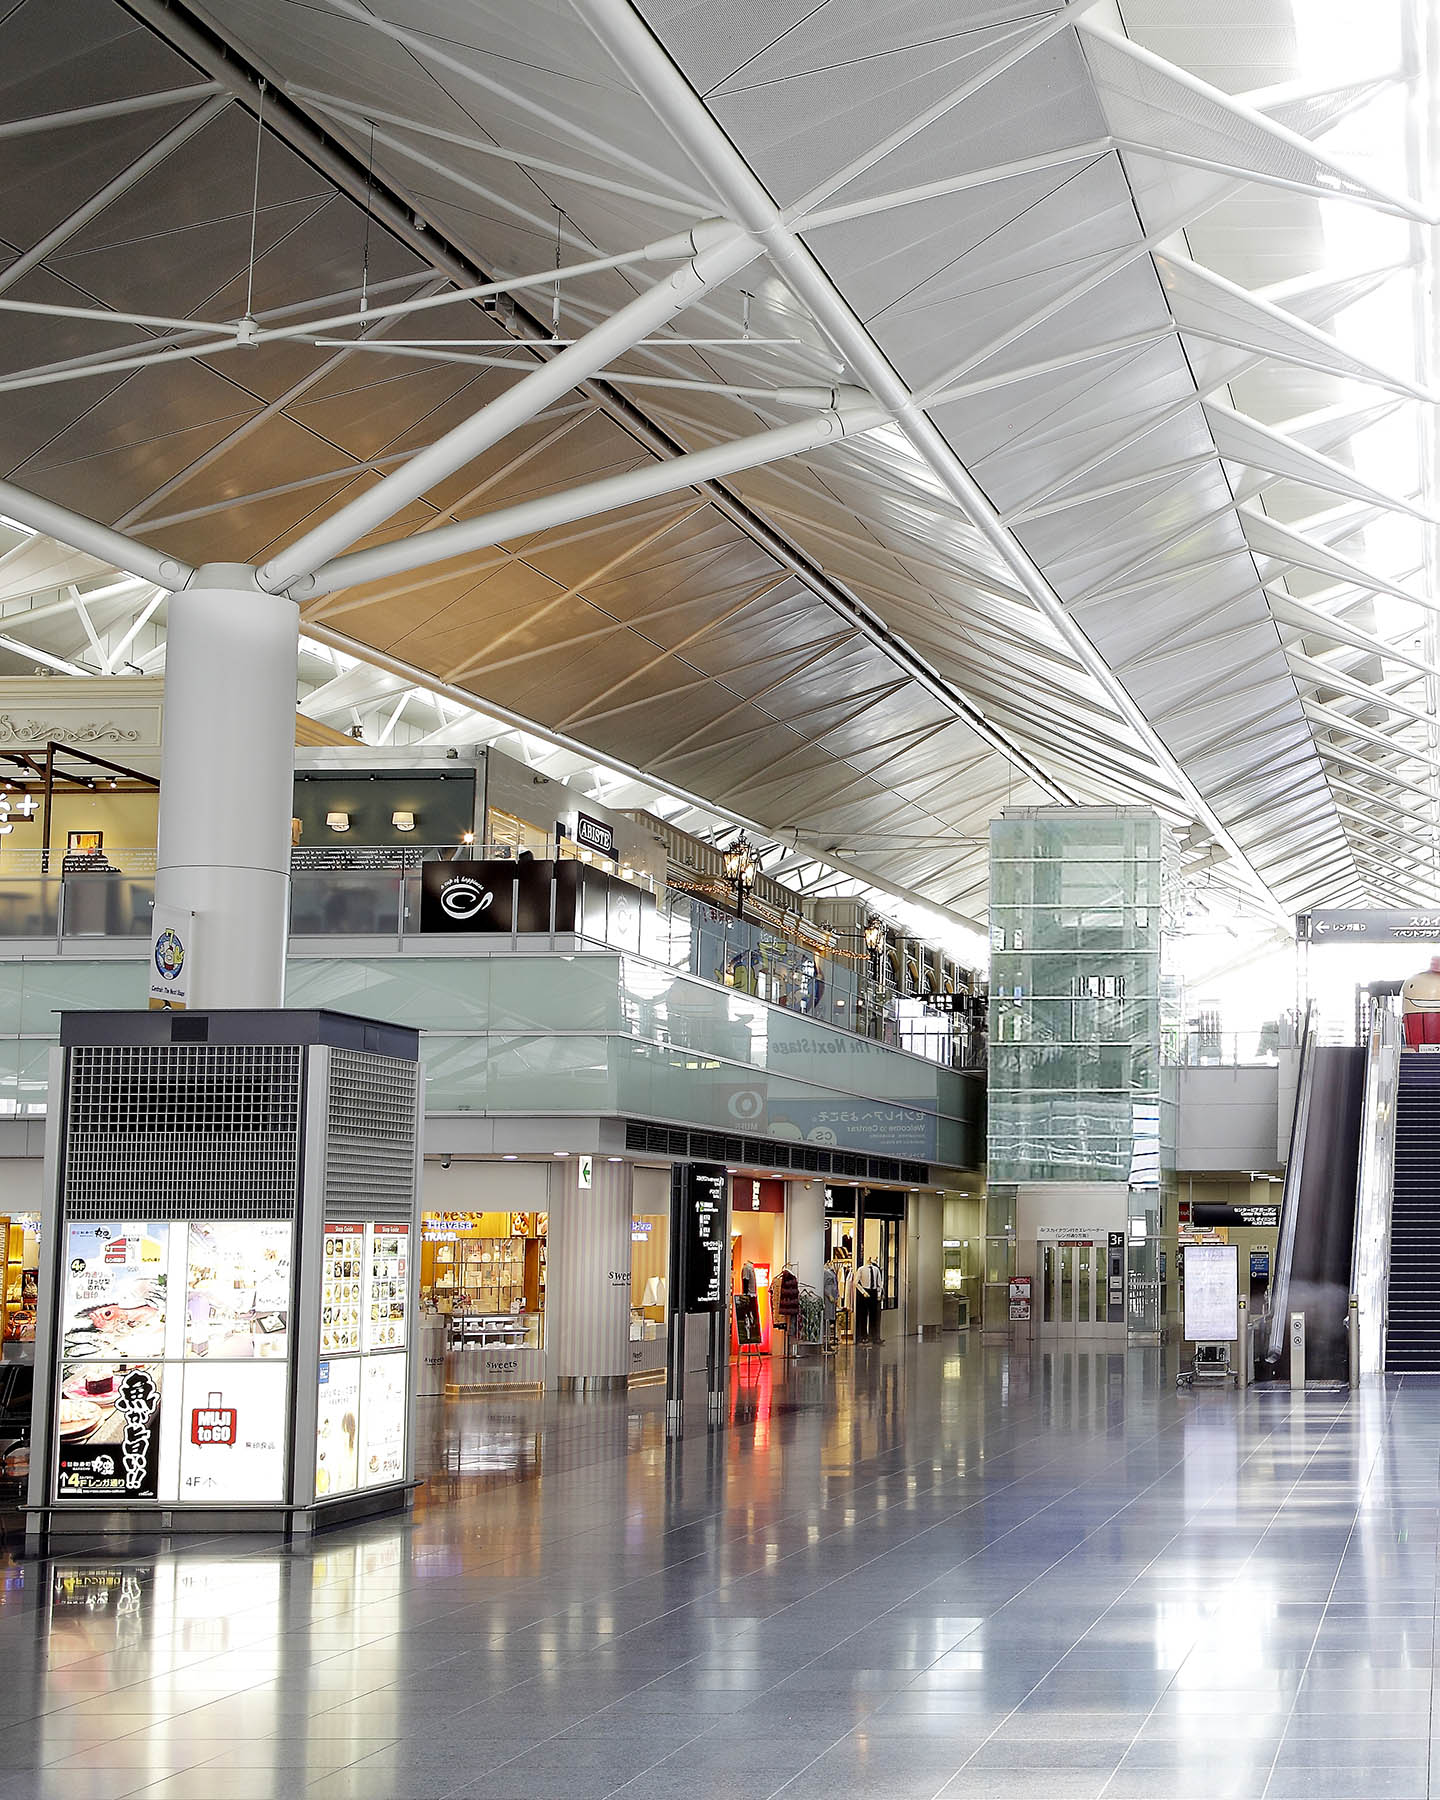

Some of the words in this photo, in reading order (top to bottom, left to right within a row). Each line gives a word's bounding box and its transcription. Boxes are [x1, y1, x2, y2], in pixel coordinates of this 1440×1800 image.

[581, 822, 610, 848] ABISTE
[1332, 923, 1366, 931] レンガ通り
[427, 1219, 473, 1230] Thavasa
[424, 1231, 460, 1242] TRAVEL
[1110, 1233, 1123, 1246] 3F
[72, 1260, 85, 1271] 4F
[197, 1410, 232, 1427] MUJI
[185, 1476, 201, 1487] 4F
